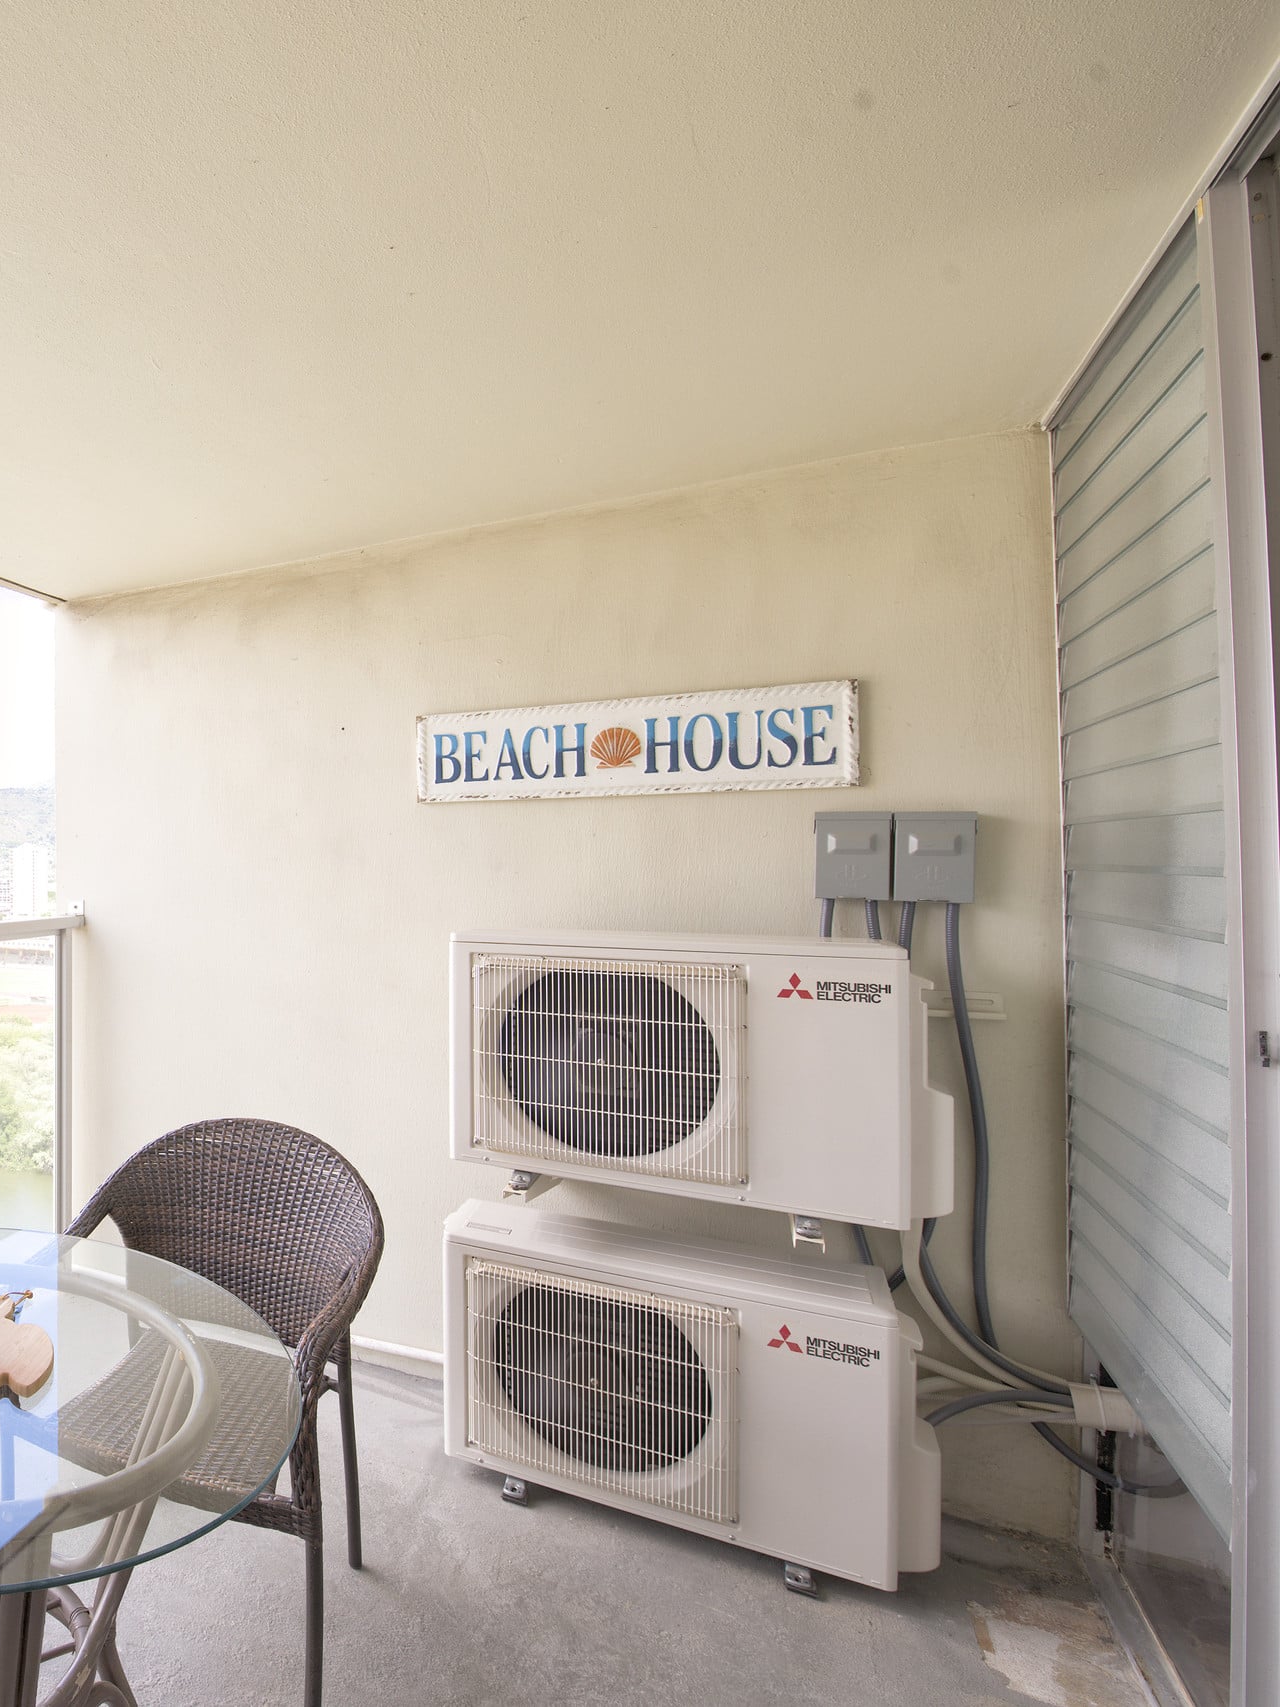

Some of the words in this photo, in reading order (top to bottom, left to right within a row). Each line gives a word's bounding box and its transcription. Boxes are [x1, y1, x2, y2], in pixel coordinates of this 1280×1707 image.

[433, 722, 588, 785] BEACH
[643, 704, 837, 774] HOUSE
[816, 981, 892, 994] MITSUBISHI
[816, 991, 881, 1003] ELECTRIC
[806, 1336, 880, 1360] MITSUBISHI
[806, 1345, 870, 1367] ELECTRIC
